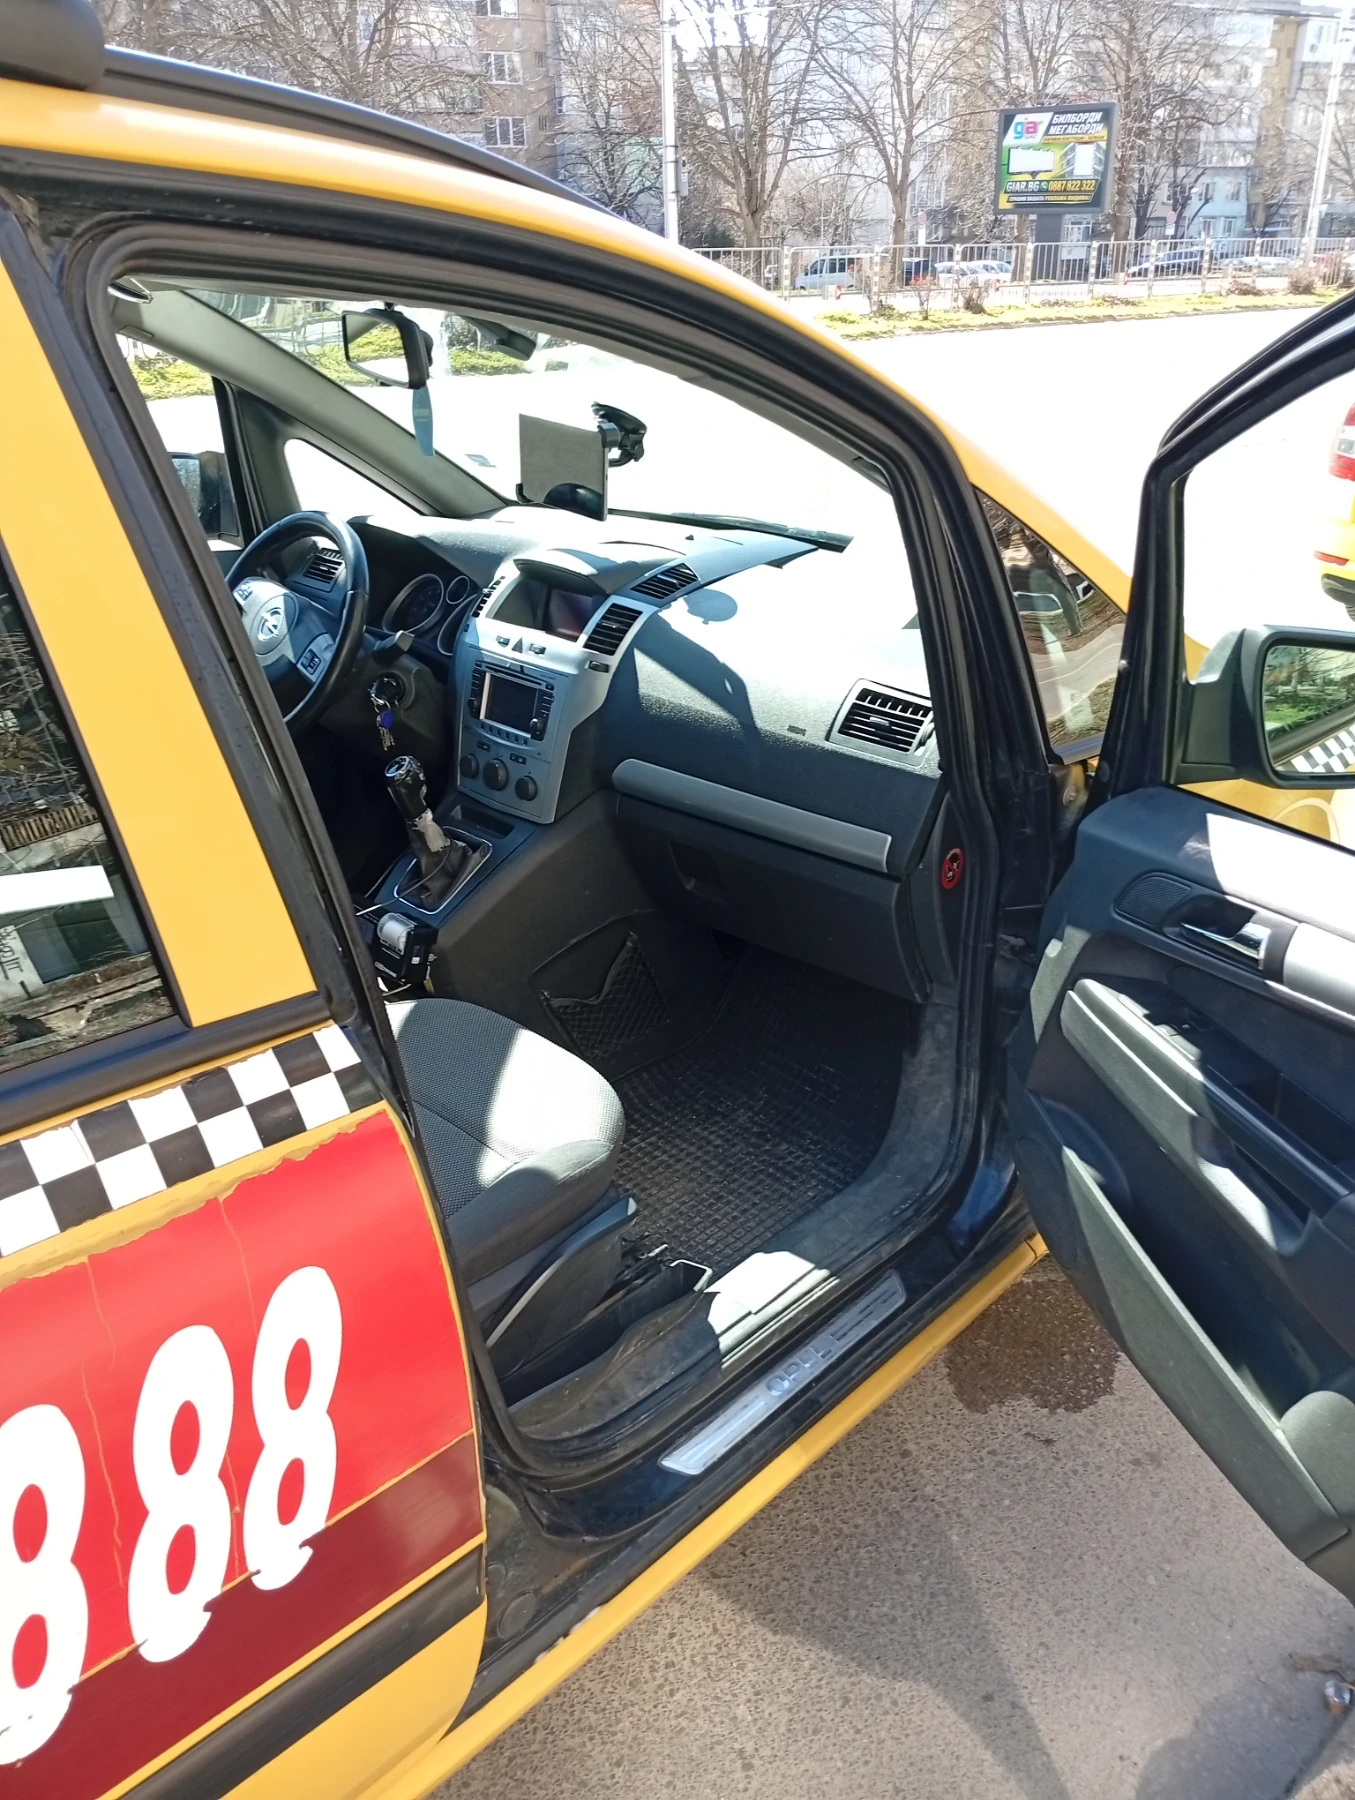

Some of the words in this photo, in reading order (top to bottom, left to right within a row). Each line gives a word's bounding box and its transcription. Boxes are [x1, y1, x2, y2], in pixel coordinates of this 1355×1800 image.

[1052, 112, 1103, 124] БИЛБОРДИ
[1048, 123, 1104, 135] МЕГАБОРДИ
[1006, 181, 1039, 192] GIAR.BG
[1048, 181, 1066, 191] 0887
[1066, 181, 1080, 191] 822
[1081, 180, 1095, 191] 322
